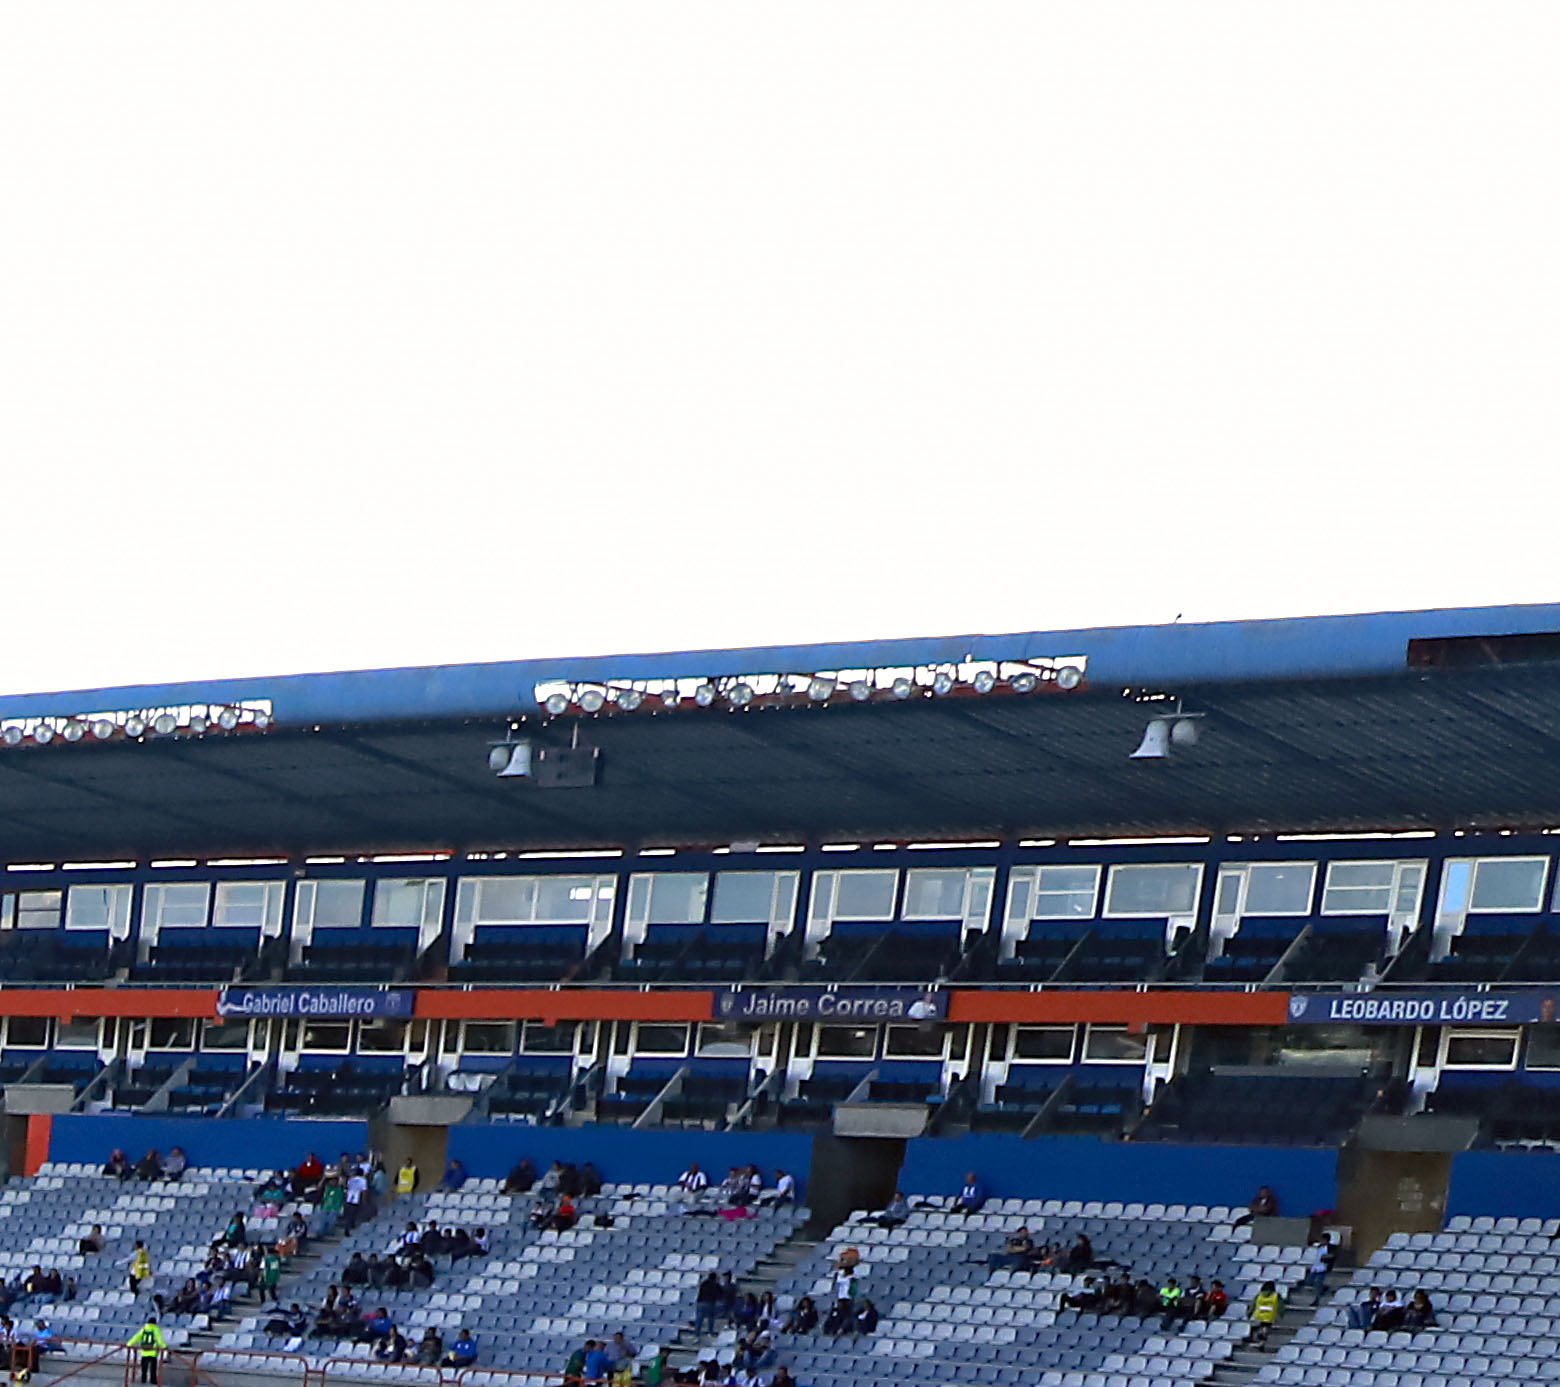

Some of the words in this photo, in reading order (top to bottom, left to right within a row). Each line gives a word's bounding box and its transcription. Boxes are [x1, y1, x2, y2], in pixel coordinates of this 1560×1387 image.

[243, 993, 295, 1013] Gabriel
[298, 992, 376, 1013] Caballero
[743, 993, 809, 1015] Jaime
[817, 994, 904, 1016] Correa
[1330, 999, 1434, 1020] LEOBARDO
[1440, 996, 1509, 1020] LÓPEZ
